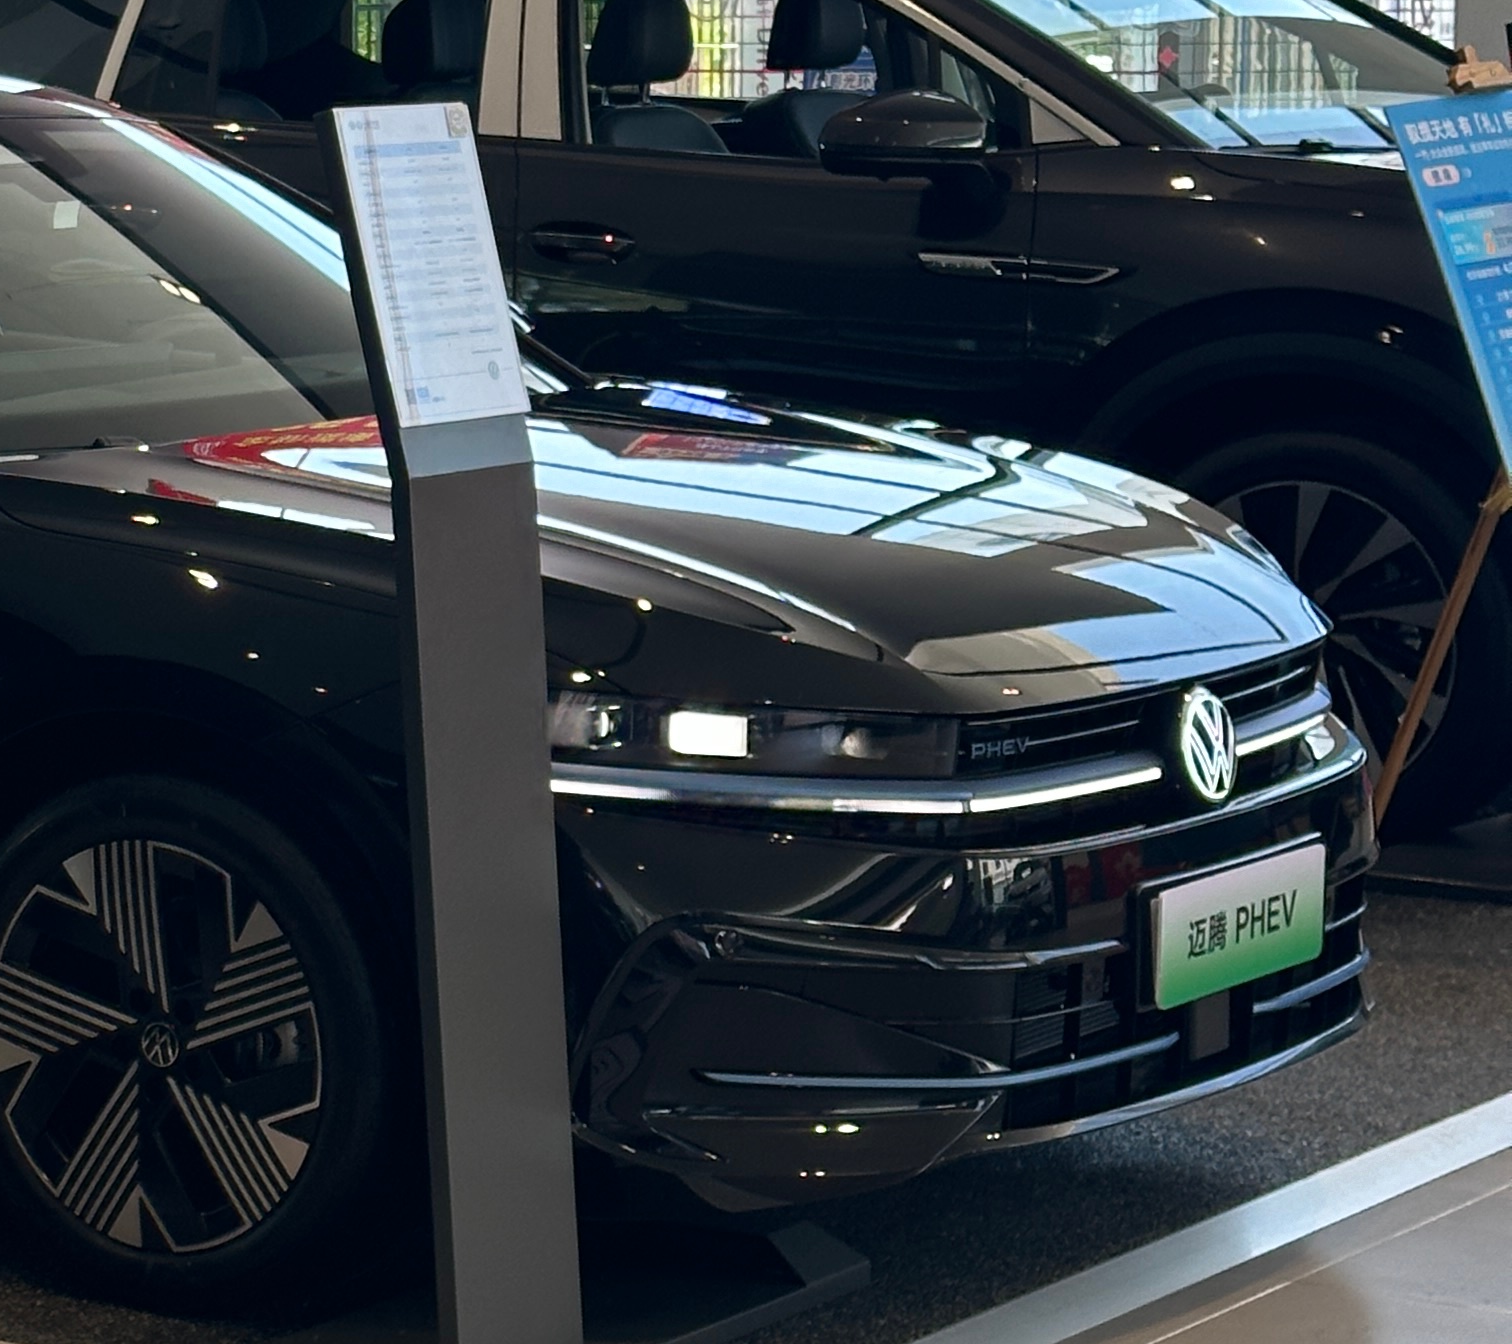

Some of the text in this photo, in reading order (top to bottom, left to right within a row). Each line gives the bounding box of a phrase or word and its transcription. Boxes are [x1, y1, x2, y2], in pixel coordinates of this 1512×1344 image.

[971, 737, 1029, 759] PHEV
[1188, 888, 1298, 959] 迈腾 PHEV
